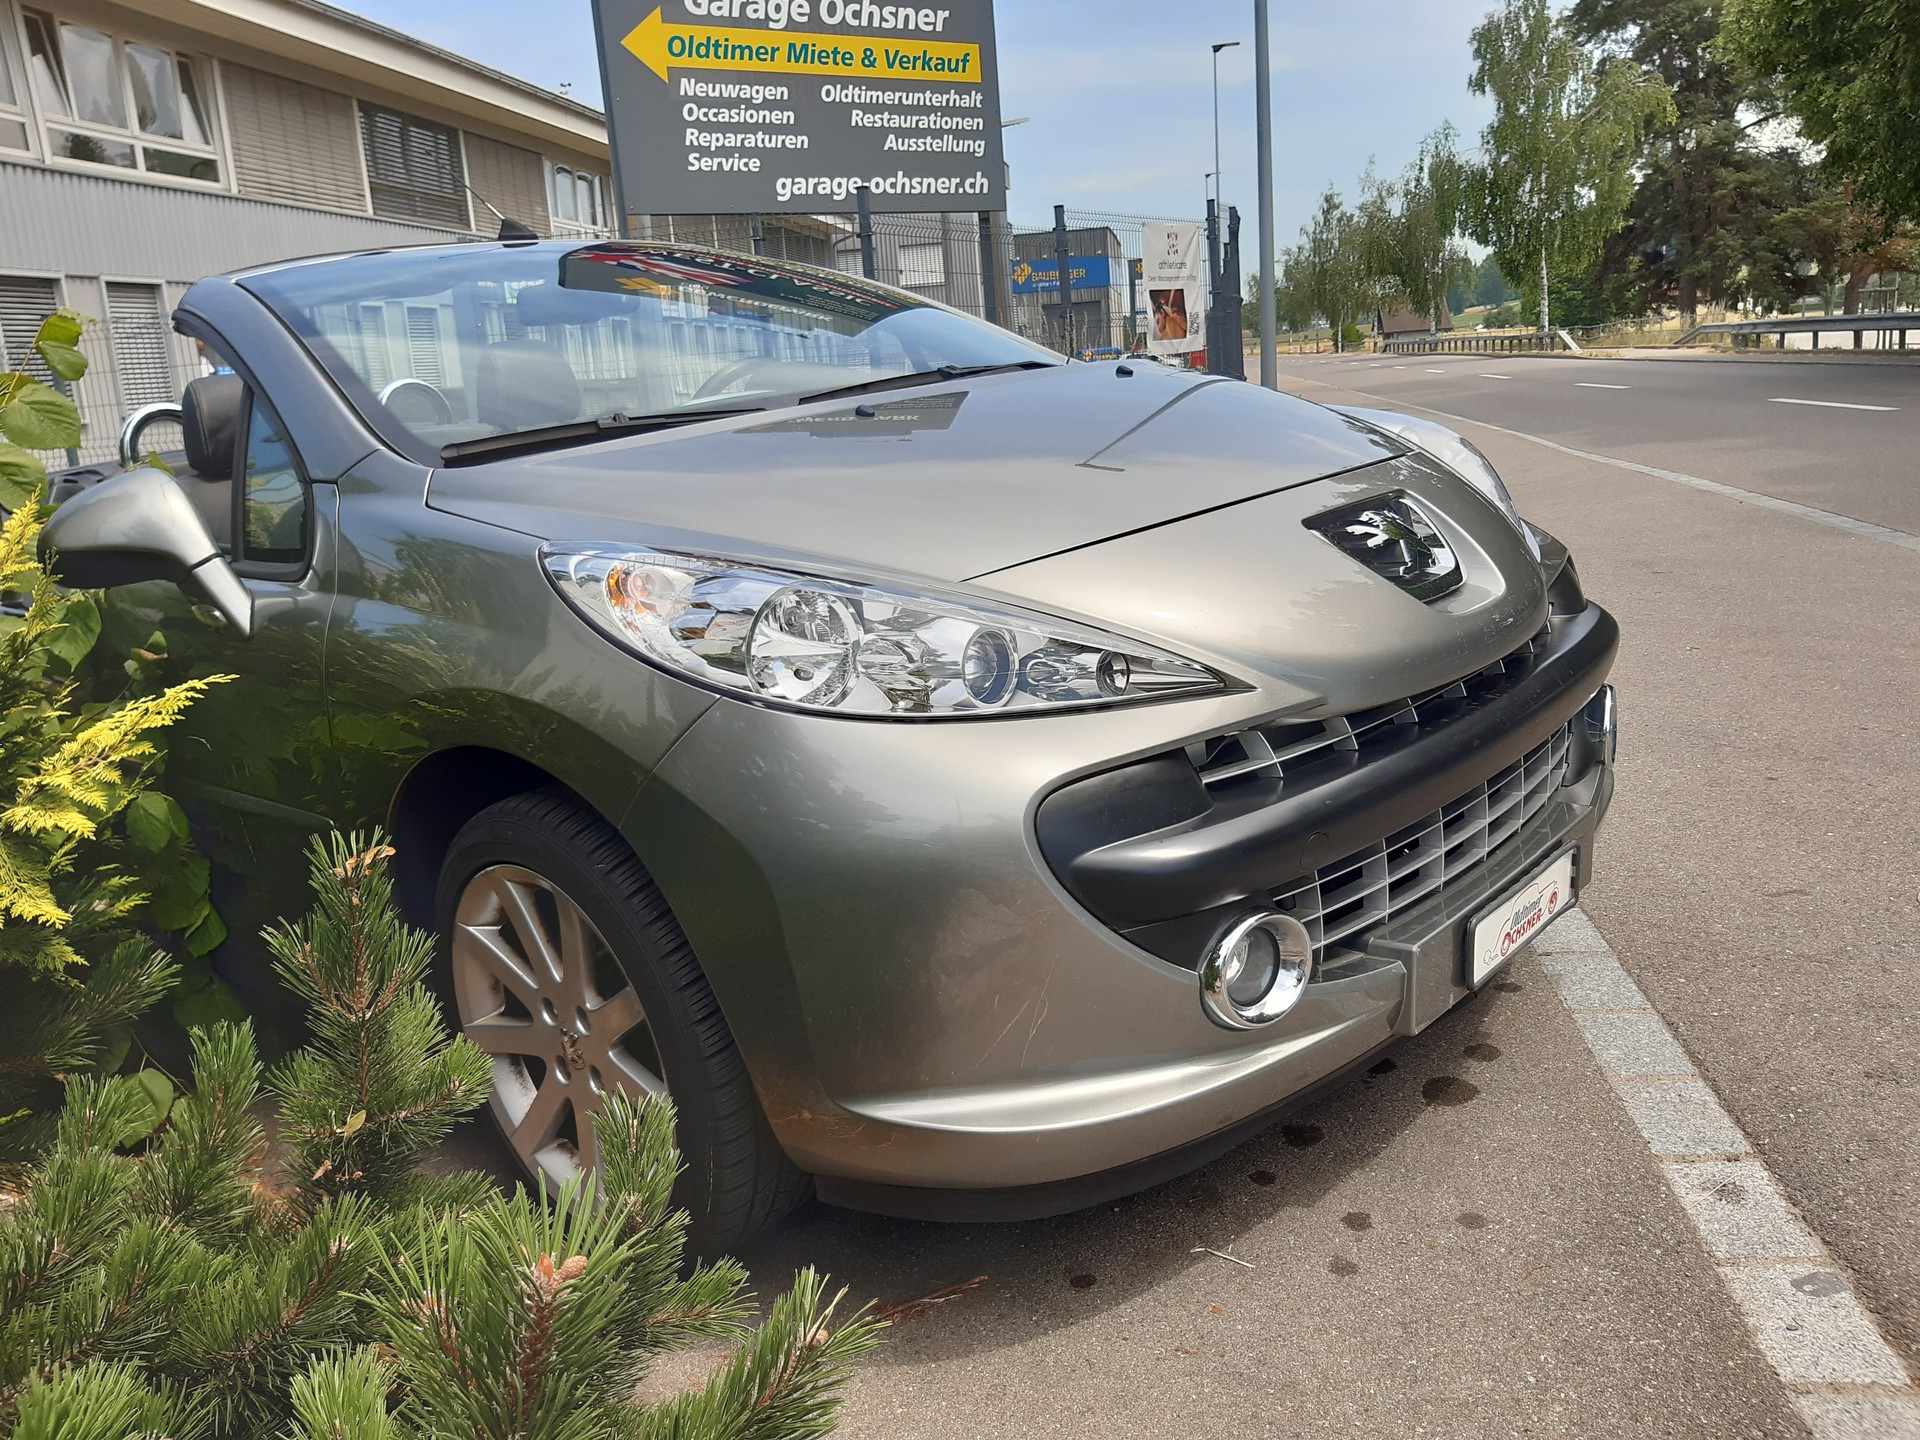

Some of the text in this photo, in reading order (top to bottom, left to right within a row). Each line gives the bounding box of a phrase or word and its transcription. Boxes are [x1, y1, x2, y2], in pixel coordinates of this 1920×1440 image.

[819, 0, 950, 32] Ochsner
[667, 35, 970, 74] Oldtimer Miete & Verkauf
[680, 78, 789, 104] Neuwagen
[820, 84, 984, 108] Oldtimerunterhalt
[682, 103, 795, 125] Occasionen
[851, 109, 984, 131] Restaurationen
[685, 128, 809, 151] Reparaturen
[883, 133, 986, 157] Ausstellung
[687, 152, 761, 172] Service
[776, 170, 989, 201] garage-ochsner.ch
